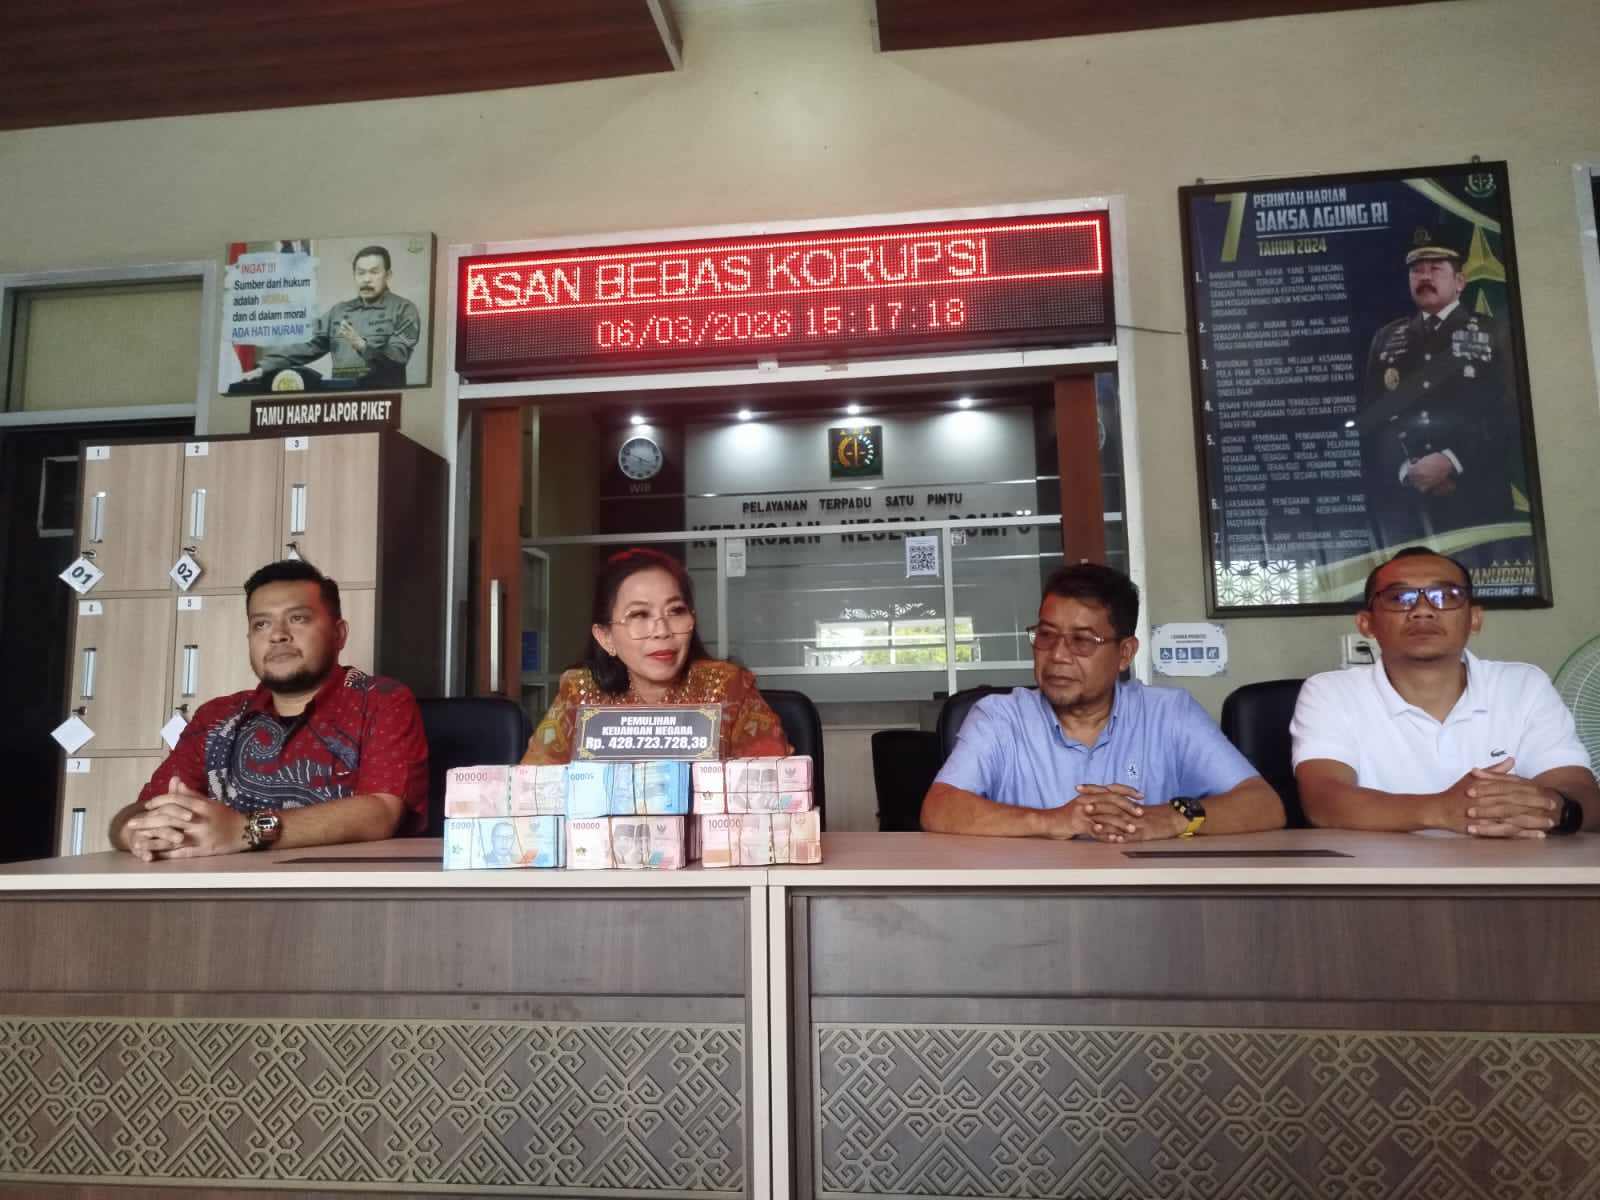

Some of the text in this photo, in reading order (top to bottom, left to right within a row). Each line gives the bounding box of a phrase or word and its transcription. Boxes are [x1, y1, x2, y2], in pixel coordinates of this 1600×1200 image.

[1252, 187, 1347, 209] PERINTAH HARIAN
[1255, 201, 1389, 232] JAKSA AGUNG RI
[1215, 191, 1248, 263] 7
[1257, 236, 1328, 257] TAHUN 2024
[241, 263, 266, 274] INGAT
[469, 238, 987, 308] ASAN BEBAS KORUPSI
[233, 277, 311, 290] Sumber dari hukum
[233, 295, 260, 306] adalah
[232, 307, 307, 322] dan di dalam moral
[597, 297, 965, 348] 06/03/2026 15:17:18
[231, 327, 250, 338] ADA
[251, 326, 271, 337] HATI
[272, 324, 305, 336] NURANI
[255, 400, 392, 427] TAMU HARAP LAPOR PIKET
[742, 492, 964, 514] PELAYANAN TERPADU SATU PINTU
[71, 565, 93, 586] 01
[176, 563, 193, 583] 02
[620, 715, 677, 726] PEMULIHAN
[601, 725, 694, 736] KEUANGAN NEGARA
[585, 736, 605, 751] Rp.
[454, 772, 489, 783] 100000
[572, 822, 600, 831] 100000
